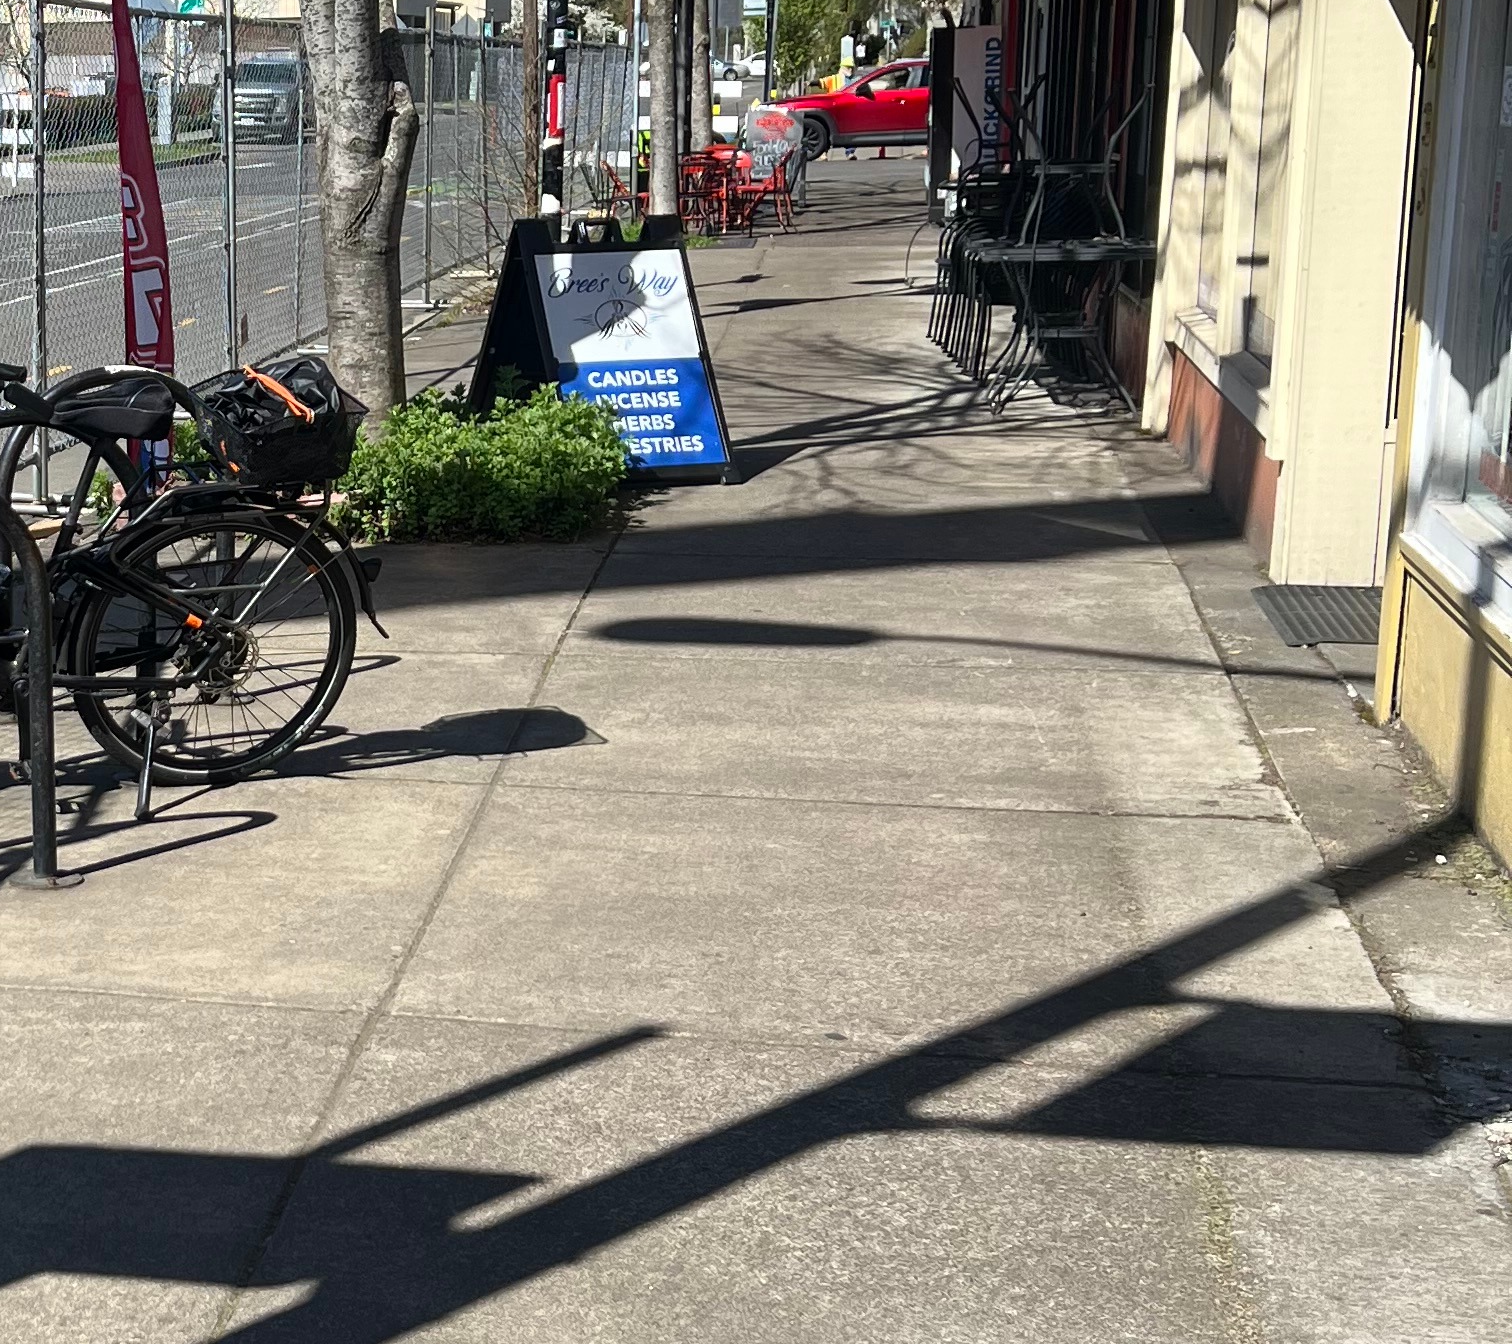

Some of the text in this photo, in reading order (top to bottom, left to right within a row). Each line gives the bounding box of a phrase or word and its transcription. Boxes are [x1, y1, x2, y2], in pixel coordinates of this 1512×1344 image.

[548, 265, 679, 299] Bree's Way
[588, 368, 679, 389] CANDLES
[596, 390, 682, 409] INCENSE
